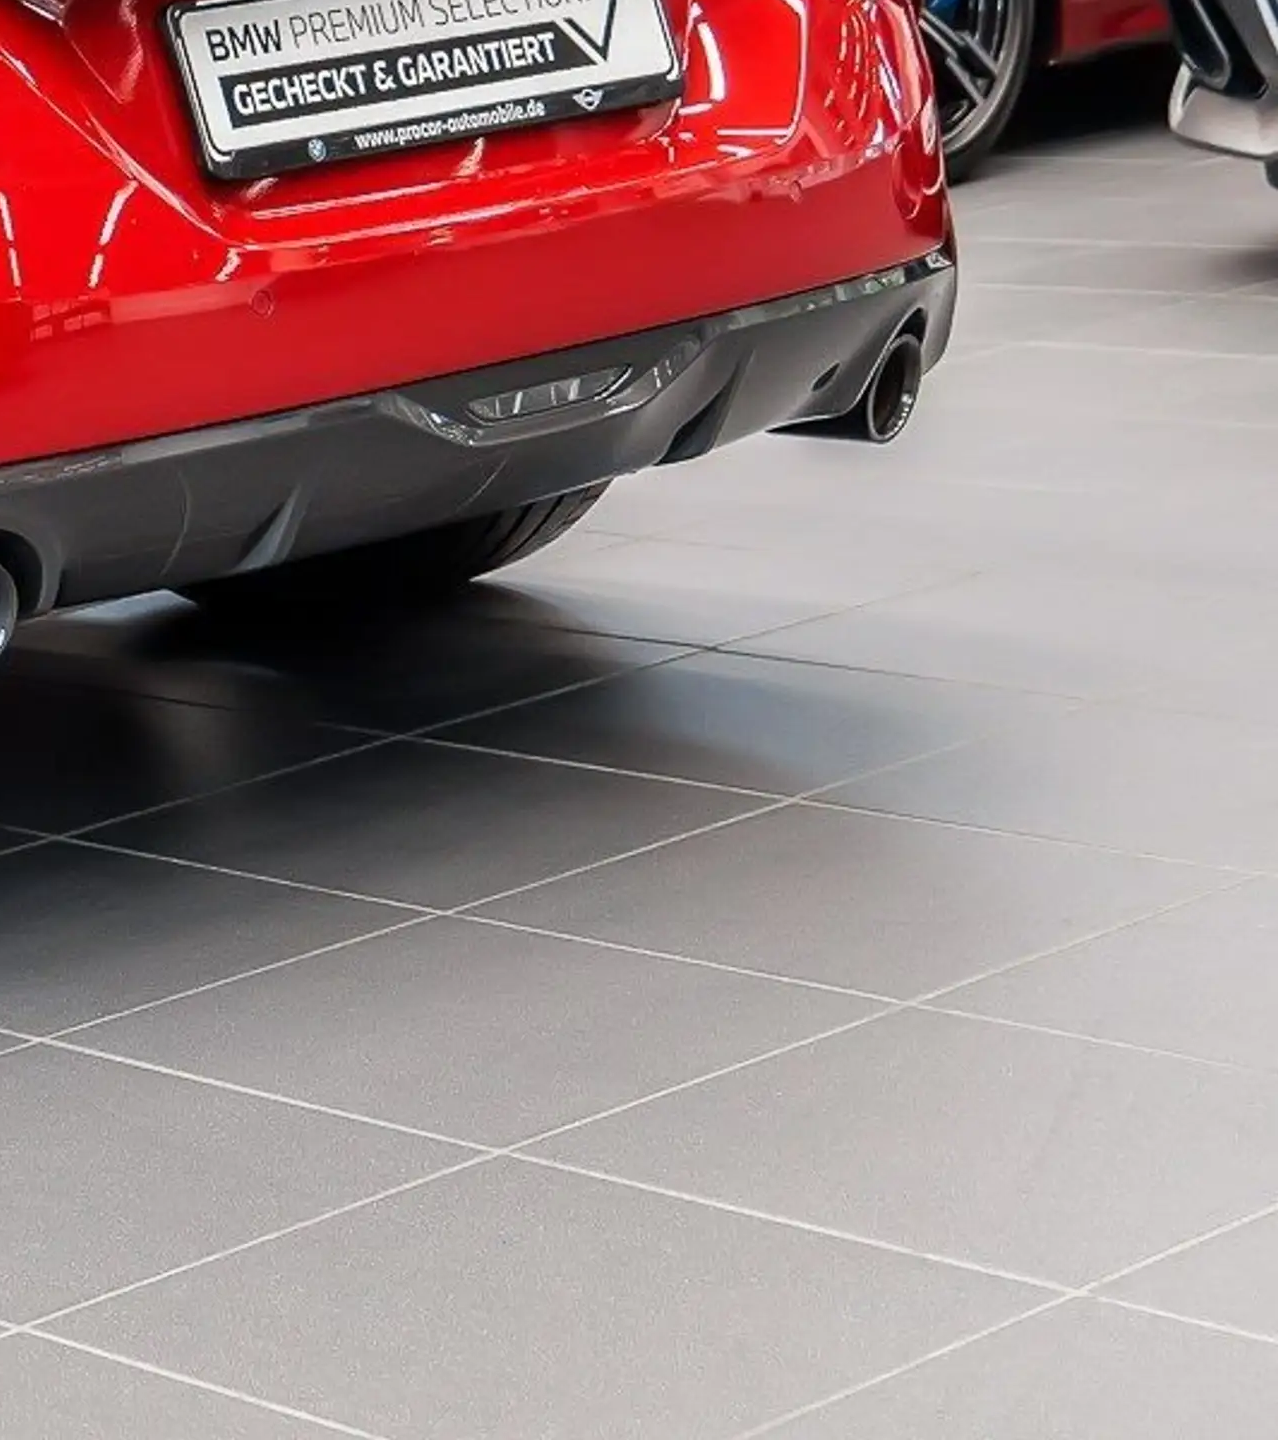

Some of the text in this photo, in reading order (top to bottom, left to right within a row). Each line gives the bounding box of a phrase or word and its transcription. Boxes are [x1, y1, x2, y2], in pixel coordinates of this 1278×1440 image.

[205, 19, 283, 62] BMW
[233, 32, 556, 116] GECHECKT & GARANTIERT
[354, 99, 546, 150] www.procar-automobile.de
